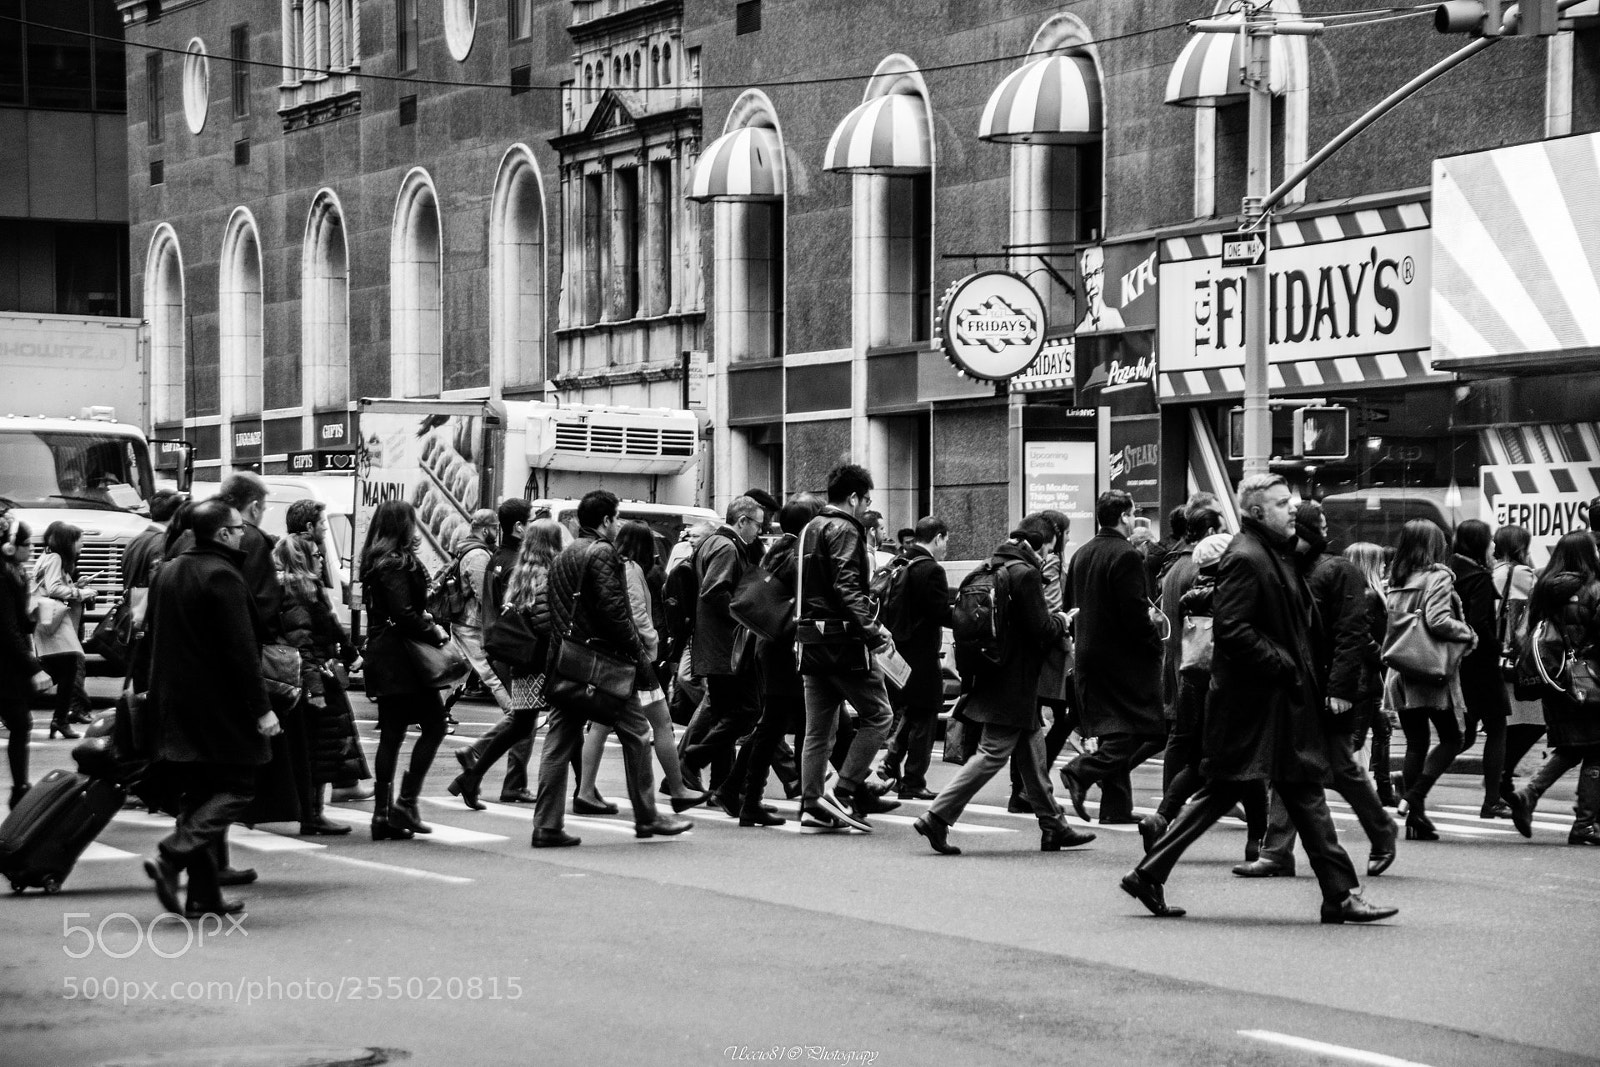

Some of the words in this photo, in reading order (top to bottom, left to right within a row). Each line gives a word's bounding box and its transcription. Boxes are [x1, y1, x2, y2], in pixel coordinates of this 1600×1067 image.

[1228, 243, 1241, 257] ONE
[1247, 241, 1262, 256] WAY
[968, 319, 1027, 331] FRIDAY'S
[1107, 360, 1135, 386] Pizza
[1135, 355, 1157, 380] Hut
[322, 423, 344, 439] GIFTS
[293, 454, 313, 469] GIFTS
[1030, 451, 1069, 461] Upcoming
[362, 481, 404, 507] MANDU
[1029, 483, 1045, 492] Erin
[1029, 492, 1056, 502] Things
[1059, 501, 1077, 510] Said
